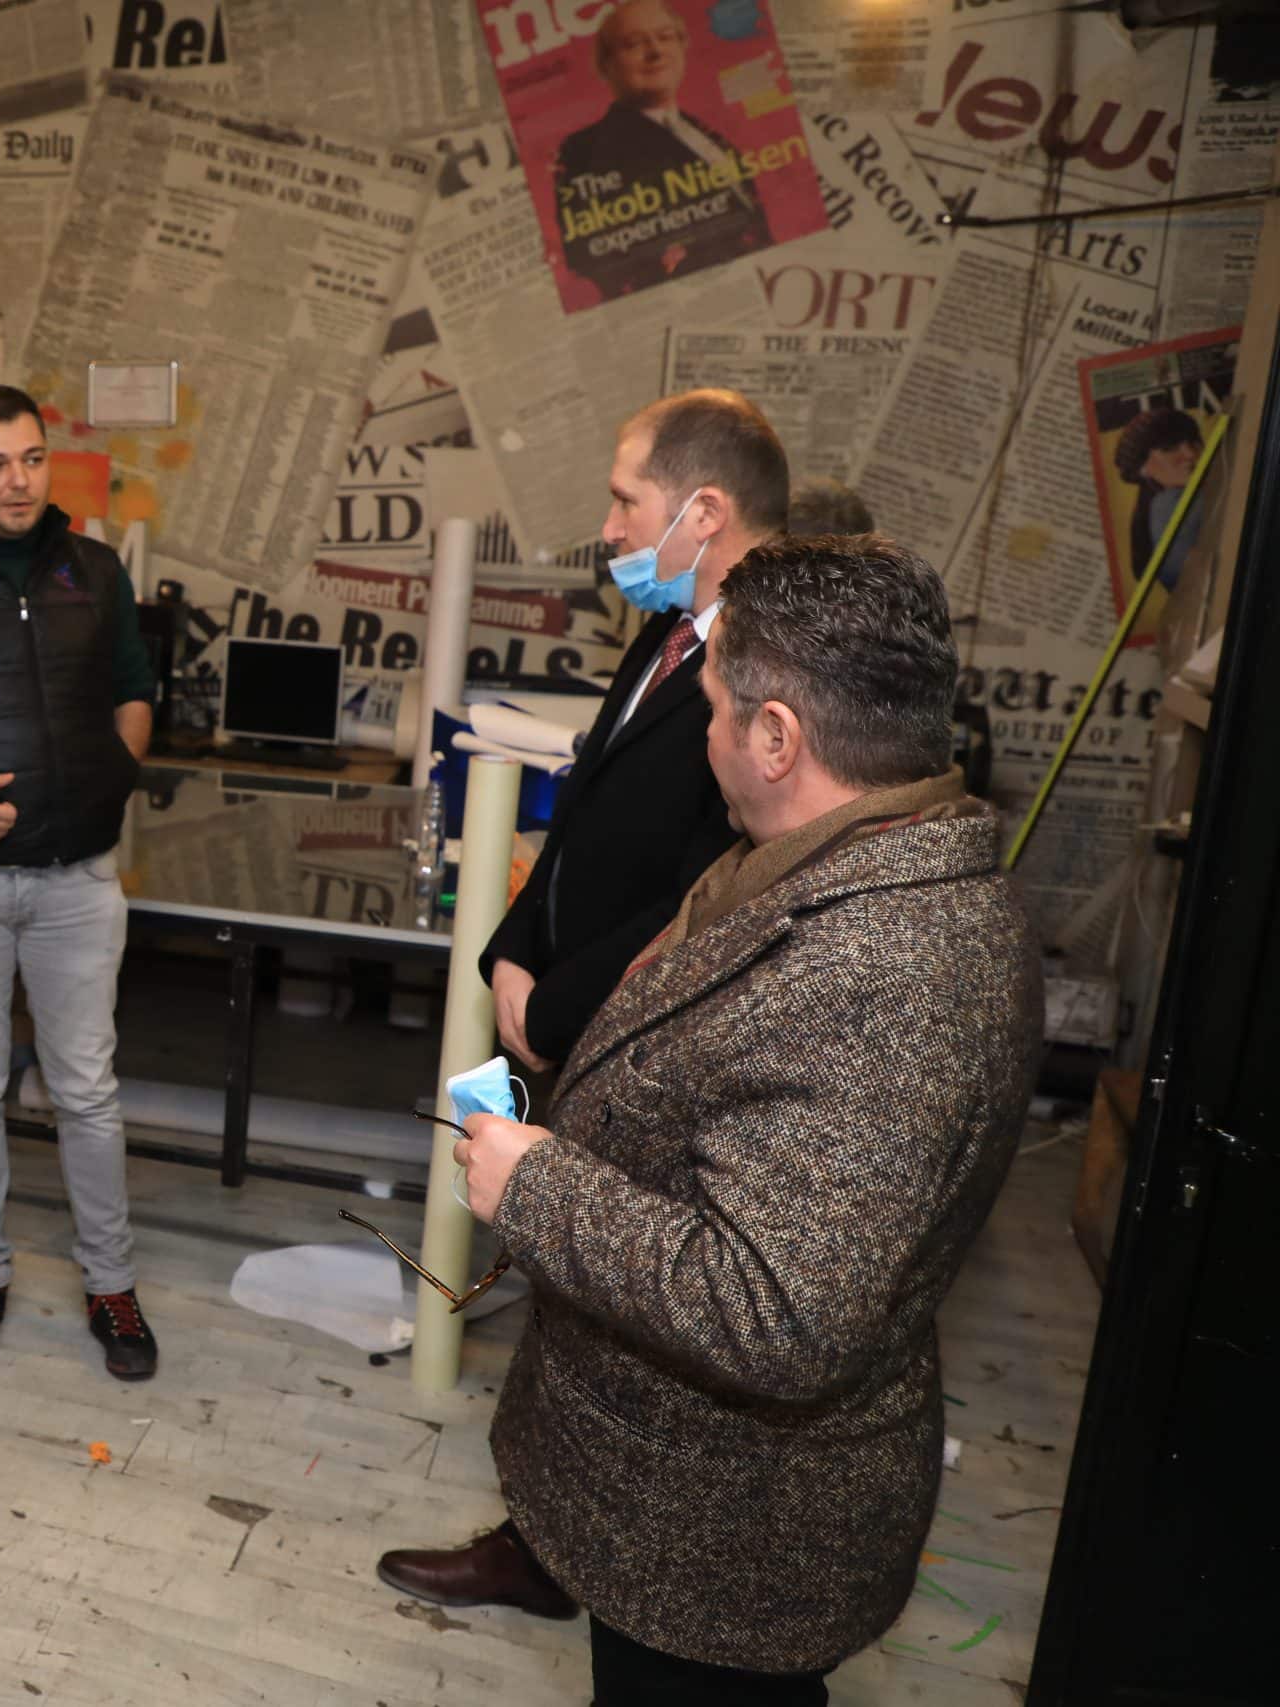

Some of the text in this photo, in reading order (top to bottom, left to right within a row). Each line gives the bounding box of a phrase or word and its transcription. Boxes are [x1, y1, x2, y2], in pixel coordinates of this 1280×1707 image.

[2, 130, 74, 165] Daily
[562, 134, 809, 242] Jakob Nielsen
[587, 192, 733, 257] experience
[1041, 216, 1148, 277] Arts
[1081, 296, 1139, 326] Local
[763, 334, 809, 353] THE
[318, 493, 424, 545] LD
